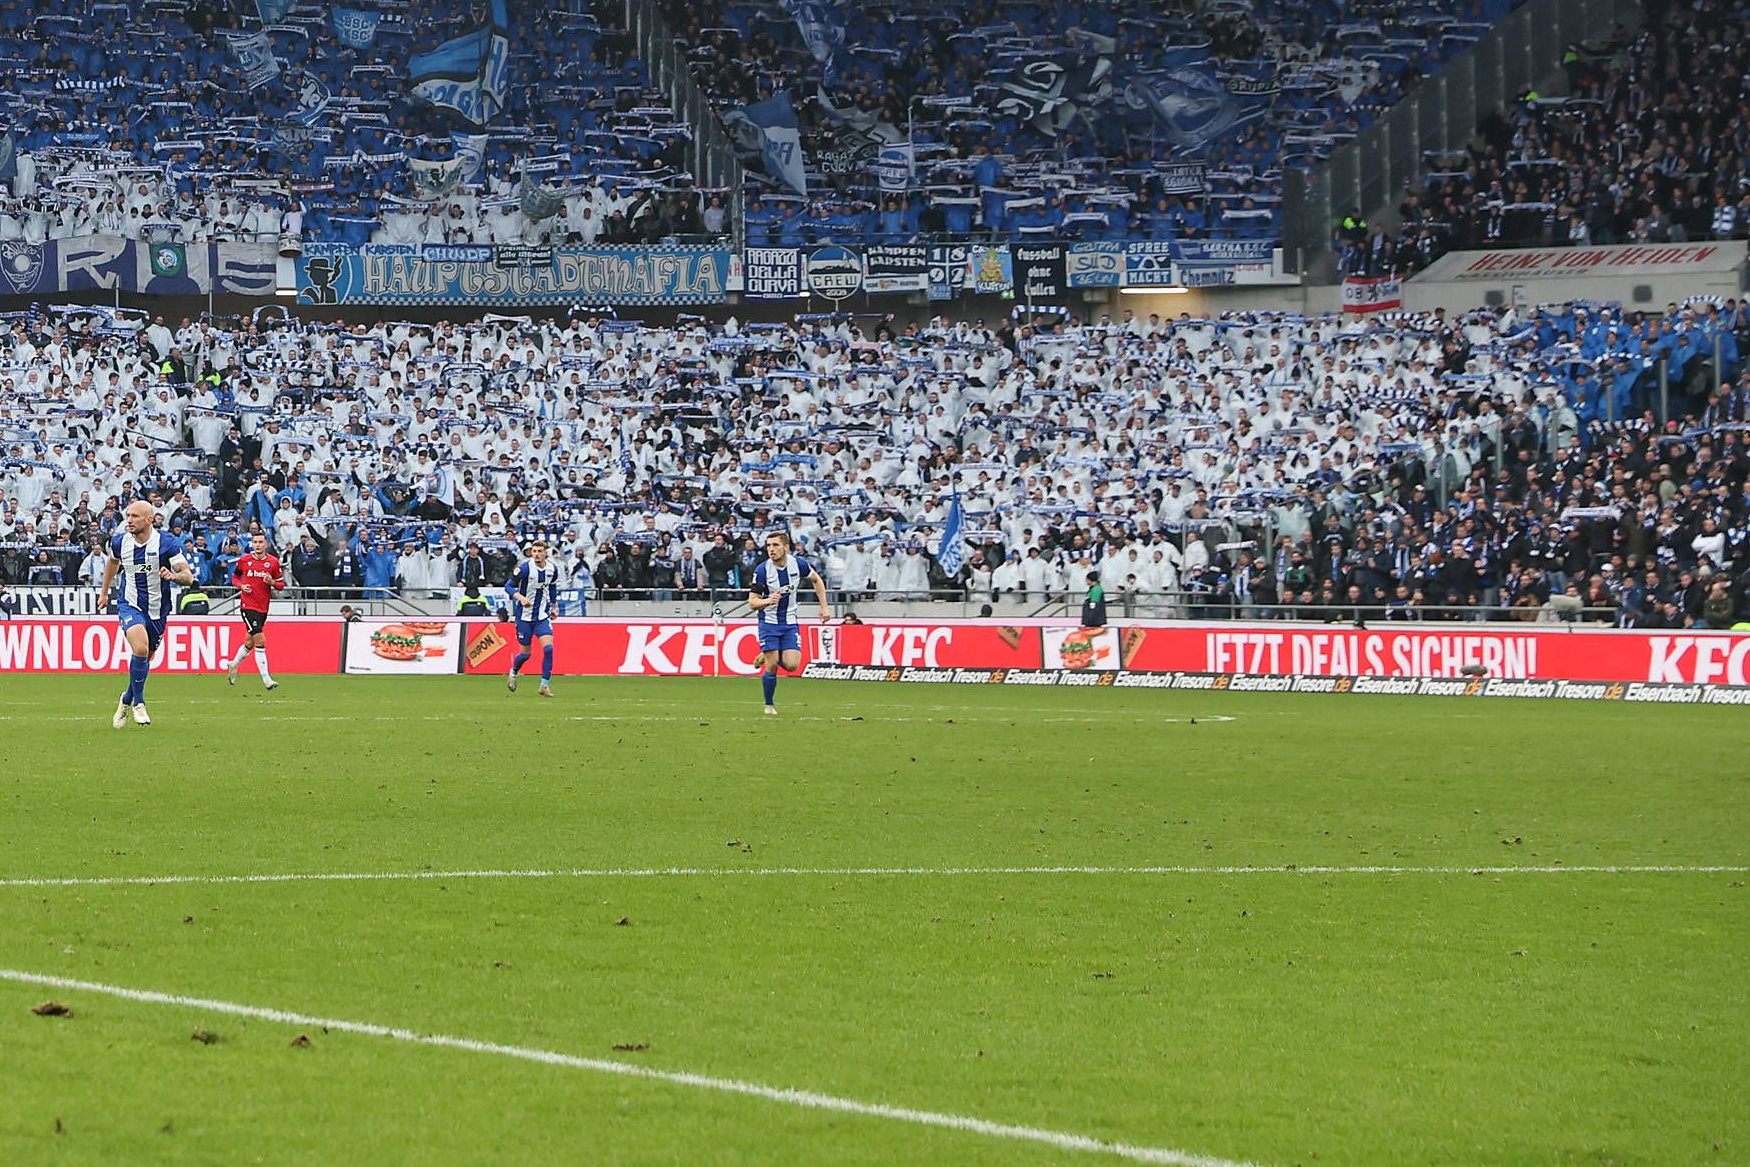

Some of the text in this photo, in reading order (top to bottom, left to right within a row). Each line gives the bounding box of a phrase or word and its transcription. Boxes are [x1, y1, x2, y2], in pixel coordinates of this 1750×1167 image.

[1128, 241, 1170, 253] SPREE
[747, 249, 798, 265] RAGAZZI
[1465, 246, 1718, 272] HEINZ VON HEIDEN
[749, 265, 797, 279] DELLA
[813, 274, 857, 287] CREW
[1128, 271, 1170, 283] MACHT
[748, 279, 798, 293] CURVA
[140, 564, 152, 572] 24
[617, 625, 763, 675] KFC
[870, 627, 953, 668] KFC
[801, 662, 852, 679] Eisenbach
[900, 666, 953, 683] Eisenbach
[1004, 668, 1059, 685] Eisenbach
[1113, 670, 1174, 688] Eisenbach
[1228, 673, 1293, 692] Eisenbach
[1351, 676, 1418, 695] Eisenbach
[1484, 678, 1556, 698] Eisenbach
[1624, 682, 1701, 703] Eisenbach
